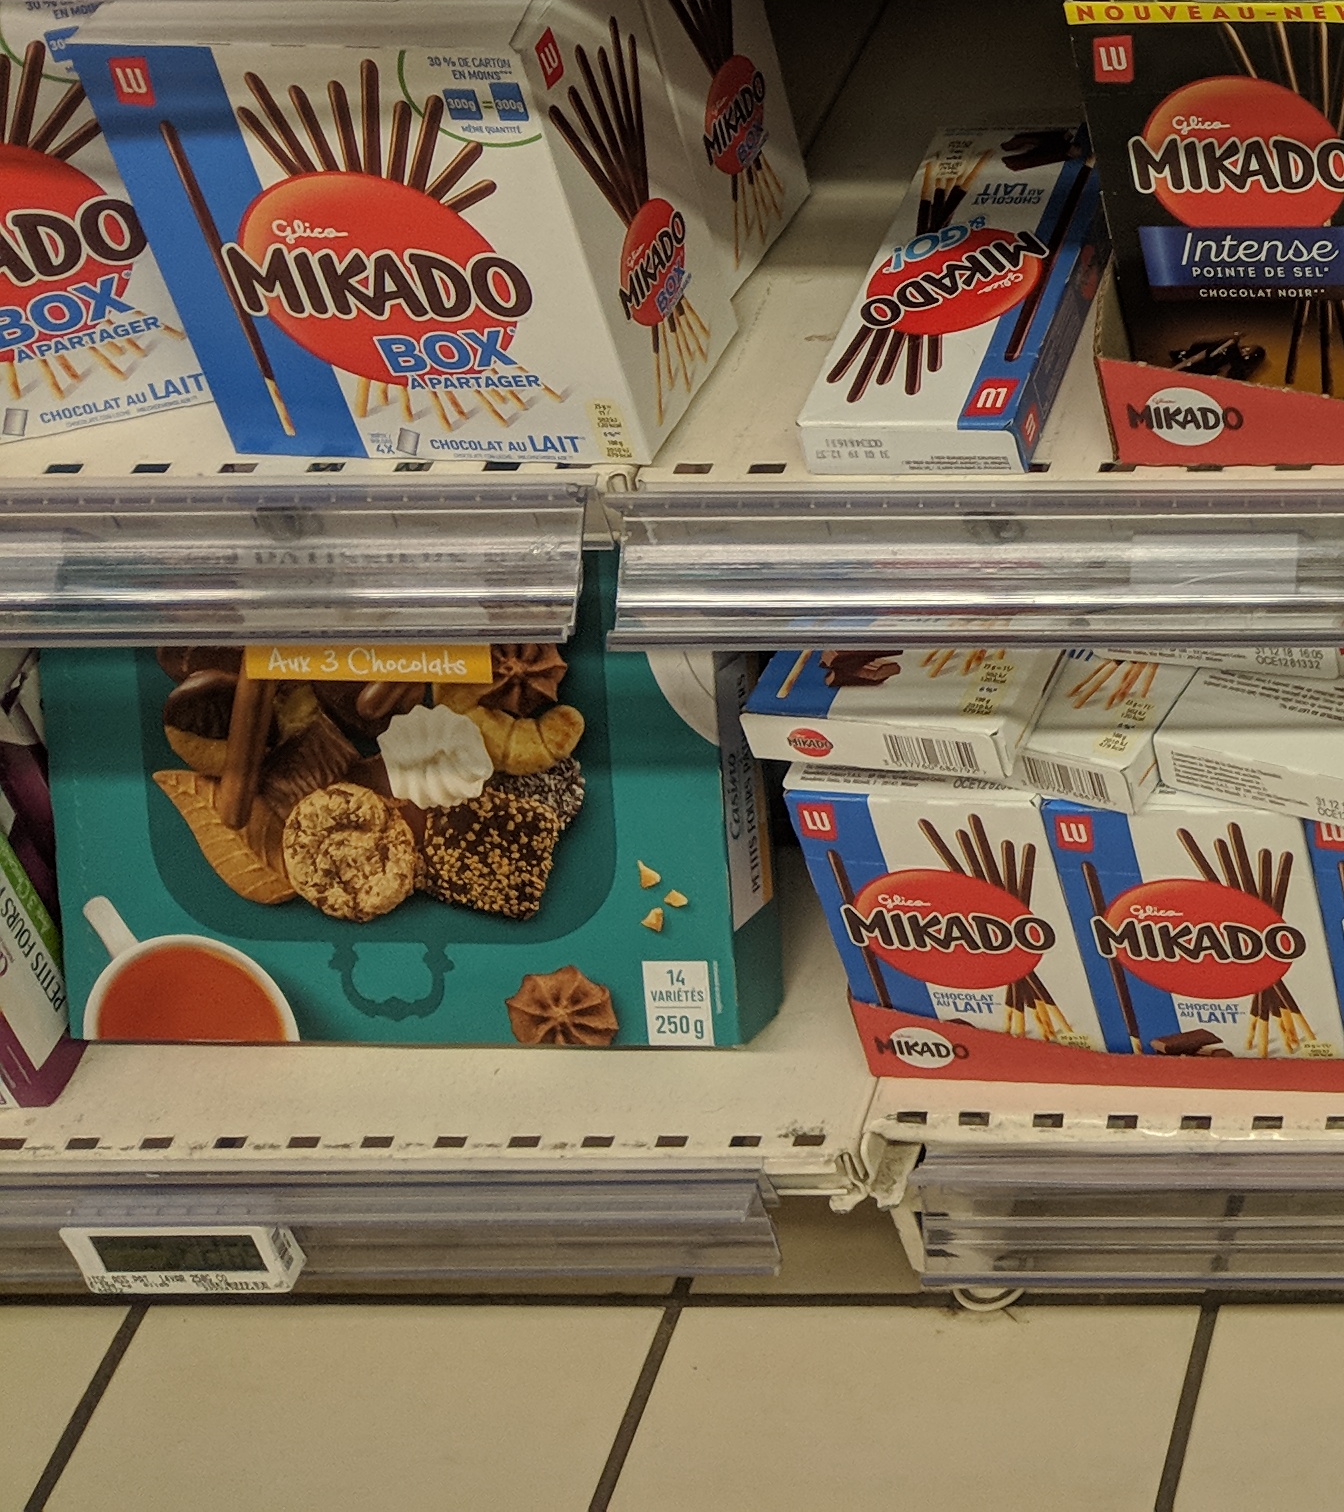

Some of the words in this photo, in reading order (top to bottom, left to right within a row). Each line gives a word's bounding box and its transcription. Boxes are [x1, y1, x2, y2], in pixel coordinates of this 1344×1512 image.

[1099, 47, 1127, 71] LU
[114, 66, 148, 94] LU
[1181, 232, 1340, 266] Intense
[1199, 288, 1272, 297] CHOCOLAT
[374, 328, 517, 375] BOX
[430, 436, 504, 452] CHOCOLAT
[507, 440, 527, 452] AU
[528, 434, 579, 454] LAIT
[267, 648, 314, 672] Aux
[321, 648, 339, 674] 3
[347, 647, 468, 677] Chocolats
[841, 905, 1056, 954] MIKADO
[1091, 916, 1306, 964] MIKADO
[666, 969, 685, 985] 14
[651, 987, 704, 1003] VARIÉTÉS
